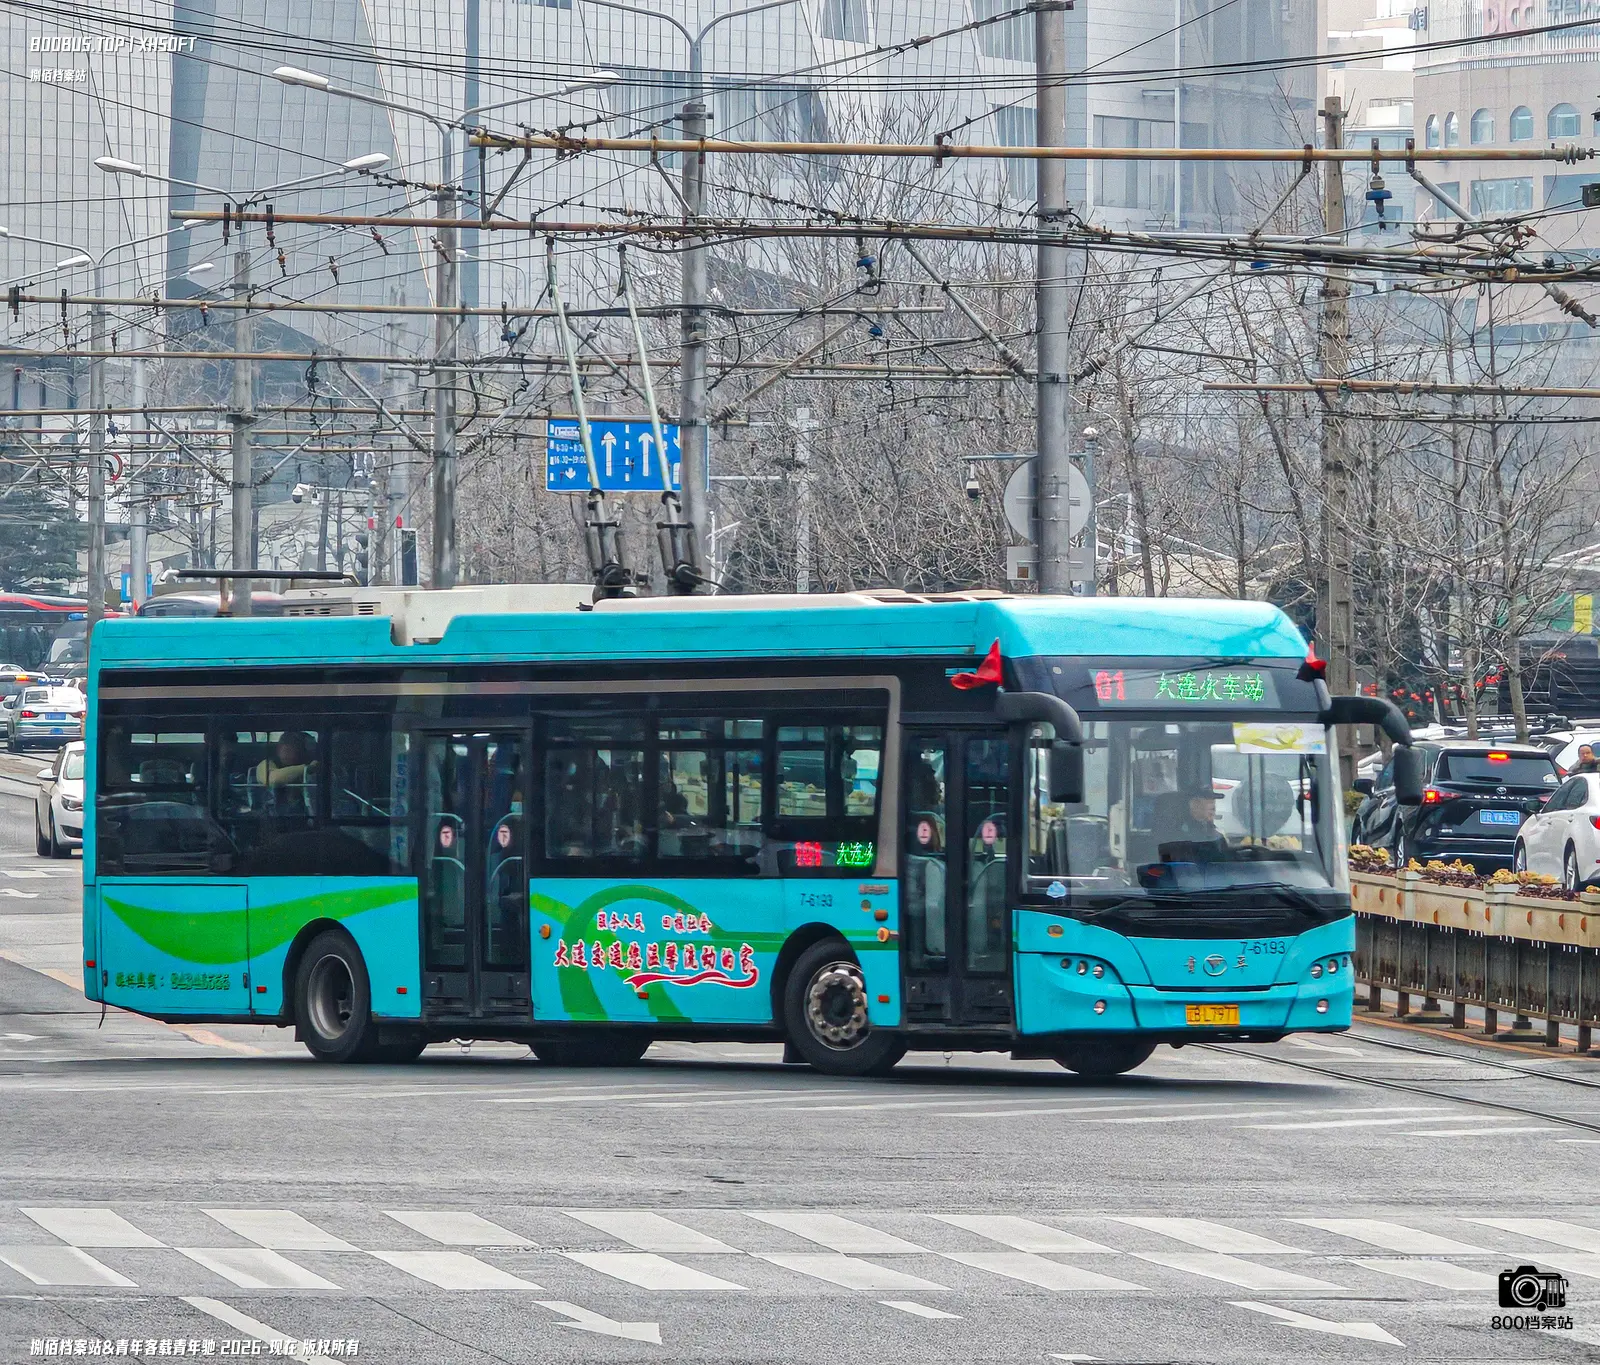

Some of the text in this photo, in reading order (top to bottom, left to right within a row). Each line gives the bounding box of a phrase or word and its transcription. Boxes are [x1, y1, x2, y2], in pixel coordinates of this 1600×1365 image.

[1154, 672, 1264, 701] 大连火车站
[1240, 941, 1286, 955] 7-6193
